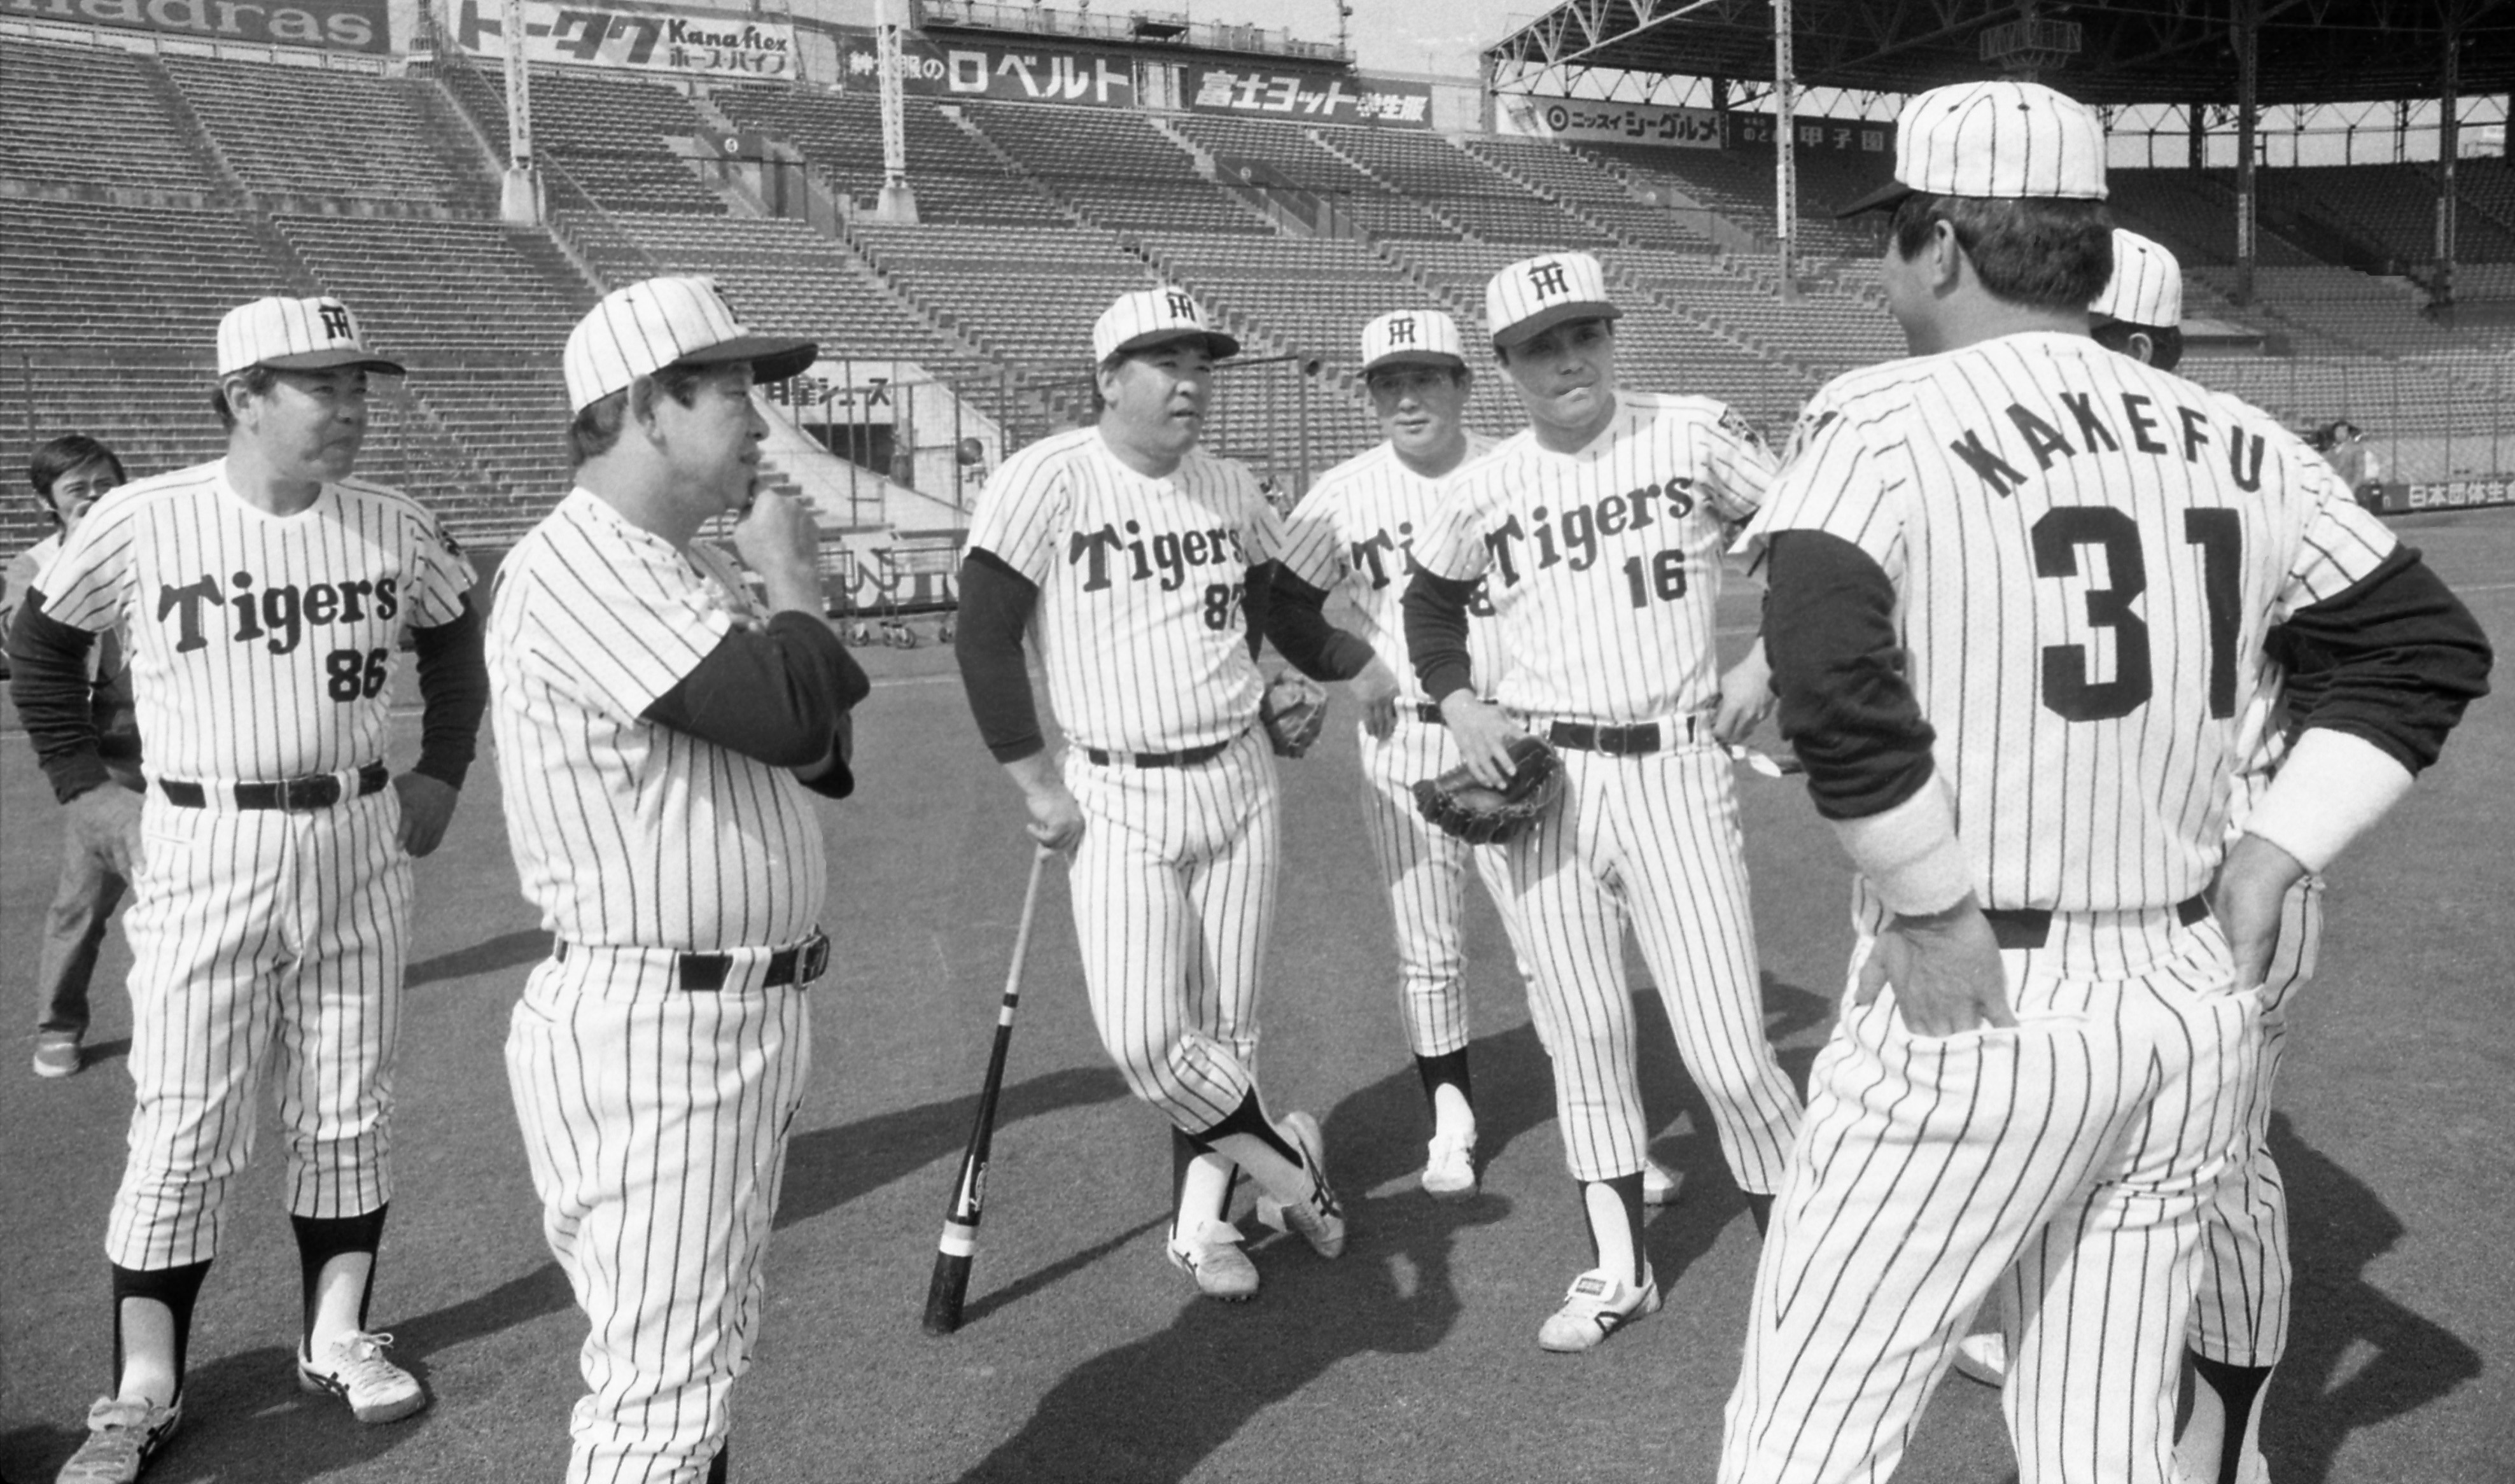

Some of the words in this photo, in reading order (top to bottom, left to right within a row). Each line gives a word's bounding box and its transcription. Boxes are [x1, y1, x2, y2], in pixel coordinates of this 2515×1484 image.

[668, 18, 788, 52] Kanaflex
[1950, 392, 2266, 499] KAKEFU
[1069, 519, 1242, 592] Tigers
[1484, 476, 1695, 588] Tigers
[158, 571, 398, 655] Tigers
[1621, 549, 1687, 609] 16
[2030, 506, 2242, 722] 31
[326, 647, 389, 704] 86
